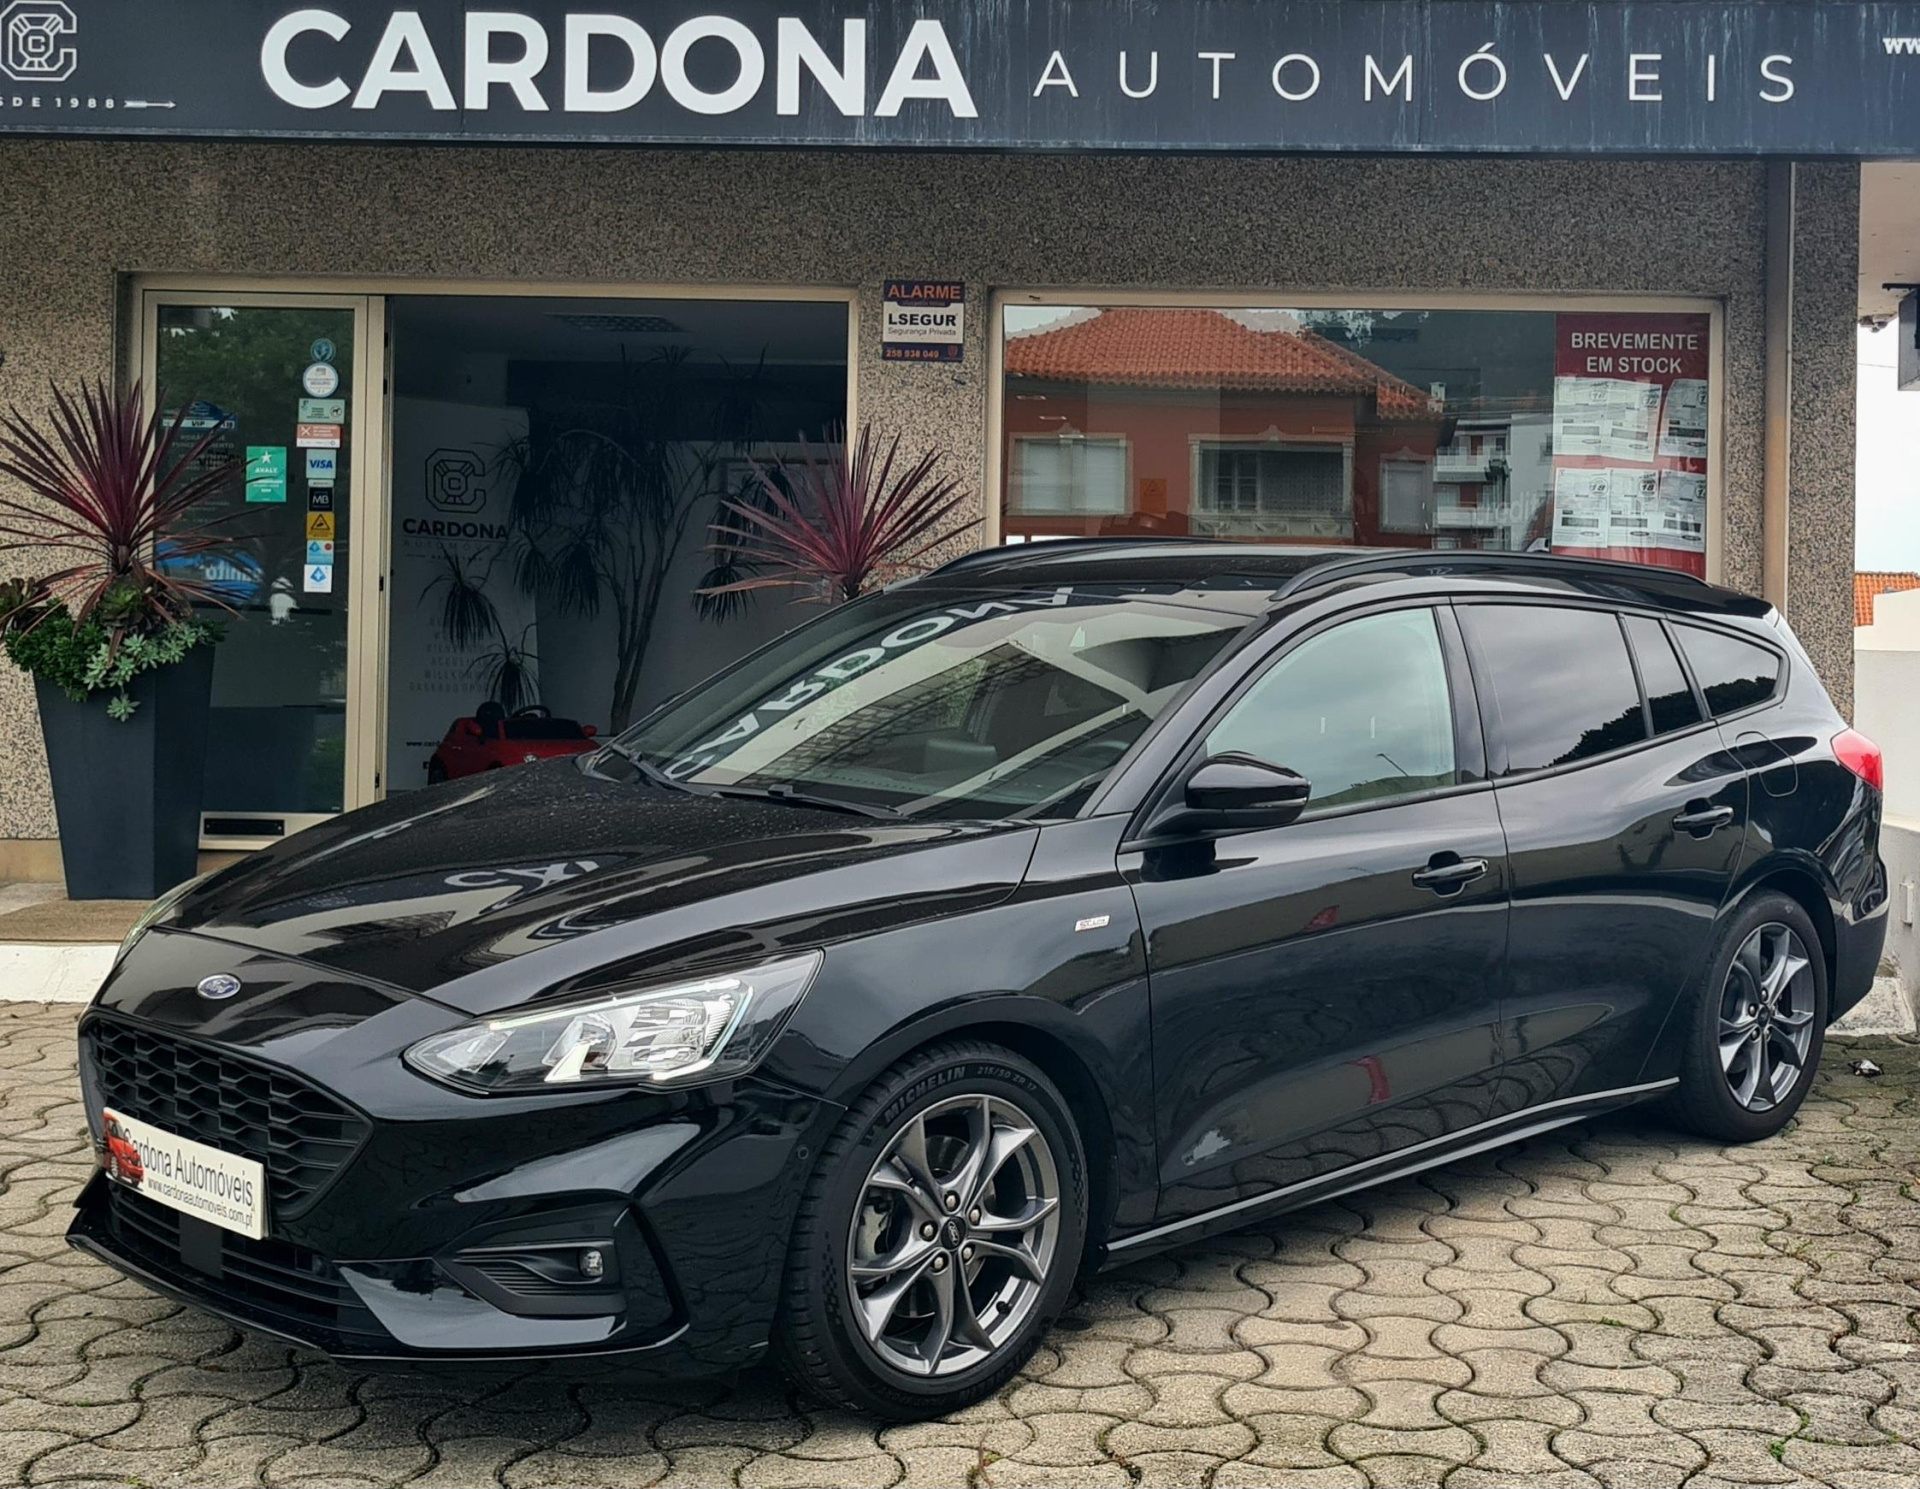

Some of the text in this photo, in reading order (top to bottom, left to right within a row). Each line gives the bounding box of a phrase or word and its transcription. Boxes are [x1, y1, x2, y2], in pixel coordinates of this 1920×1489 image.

[260, 8, 1797, 120] CARDONA AUTOMÓVEIS
[55, 97, 115, 109] 1988
[887, 284, 961, 300] ALARME
[888, 313, 957, 326] LSEGUR
[888, 327, 957, 336] Segurança Privada
[1571, 332, 1698, 350] BREVEMENTE
[1586, 356, 1682, 374] EM STOCK
[309, 459, 333, 469] VISA
[312, 494, 329, 504] MB
[402, 517, 508, 539] CARDONA
[883, 1066, 966, 1124] MICHELIN
[174, 1149, 254, 1207] Automóveis
